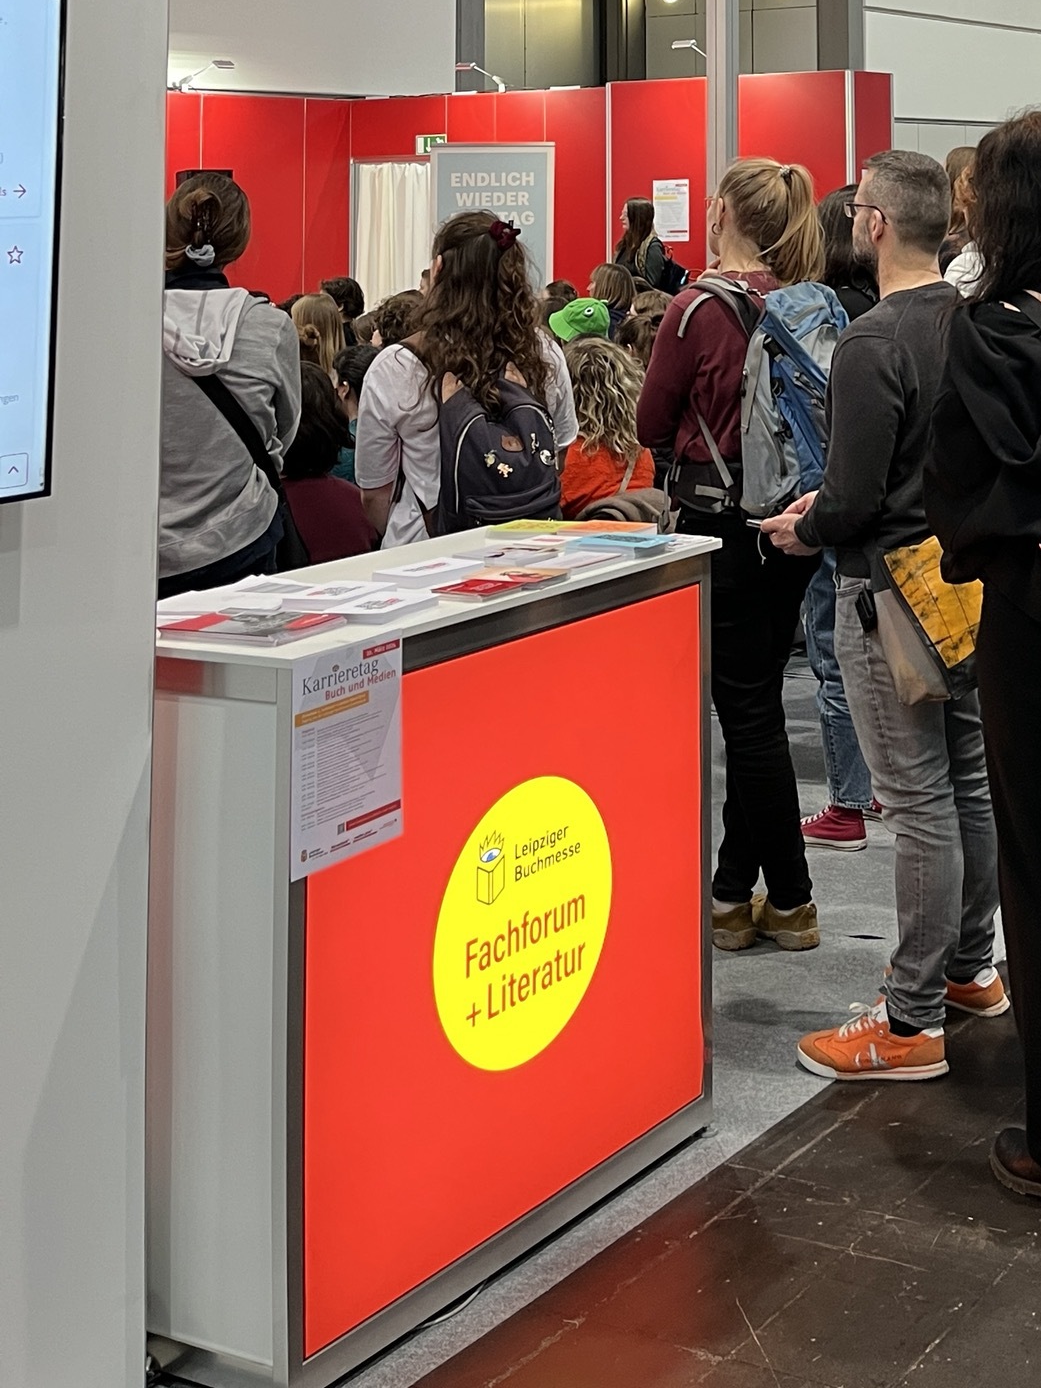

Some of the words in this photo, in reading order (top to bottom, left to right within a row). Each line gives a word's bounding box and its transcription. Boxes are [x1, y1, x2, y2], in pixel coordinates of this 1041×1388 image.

[450, 172, 535, 187] ENDLICH
[456, 192, 530, 207] WIEDER
[302, 659, 379, 696] Karrieretag
[325, 686, 345, 701] Buch
[348, 678, 364, 692] und
[367, 669, 396, 686] Medien
[515, 825, 569, 860] Leipziger
[515, 842, 581, 882] Buchmesse
[466, 894, 586, 979] Fachforum
[466, 1002, 482, 1027] +
[488, 942, 586, 1020] Literatur
